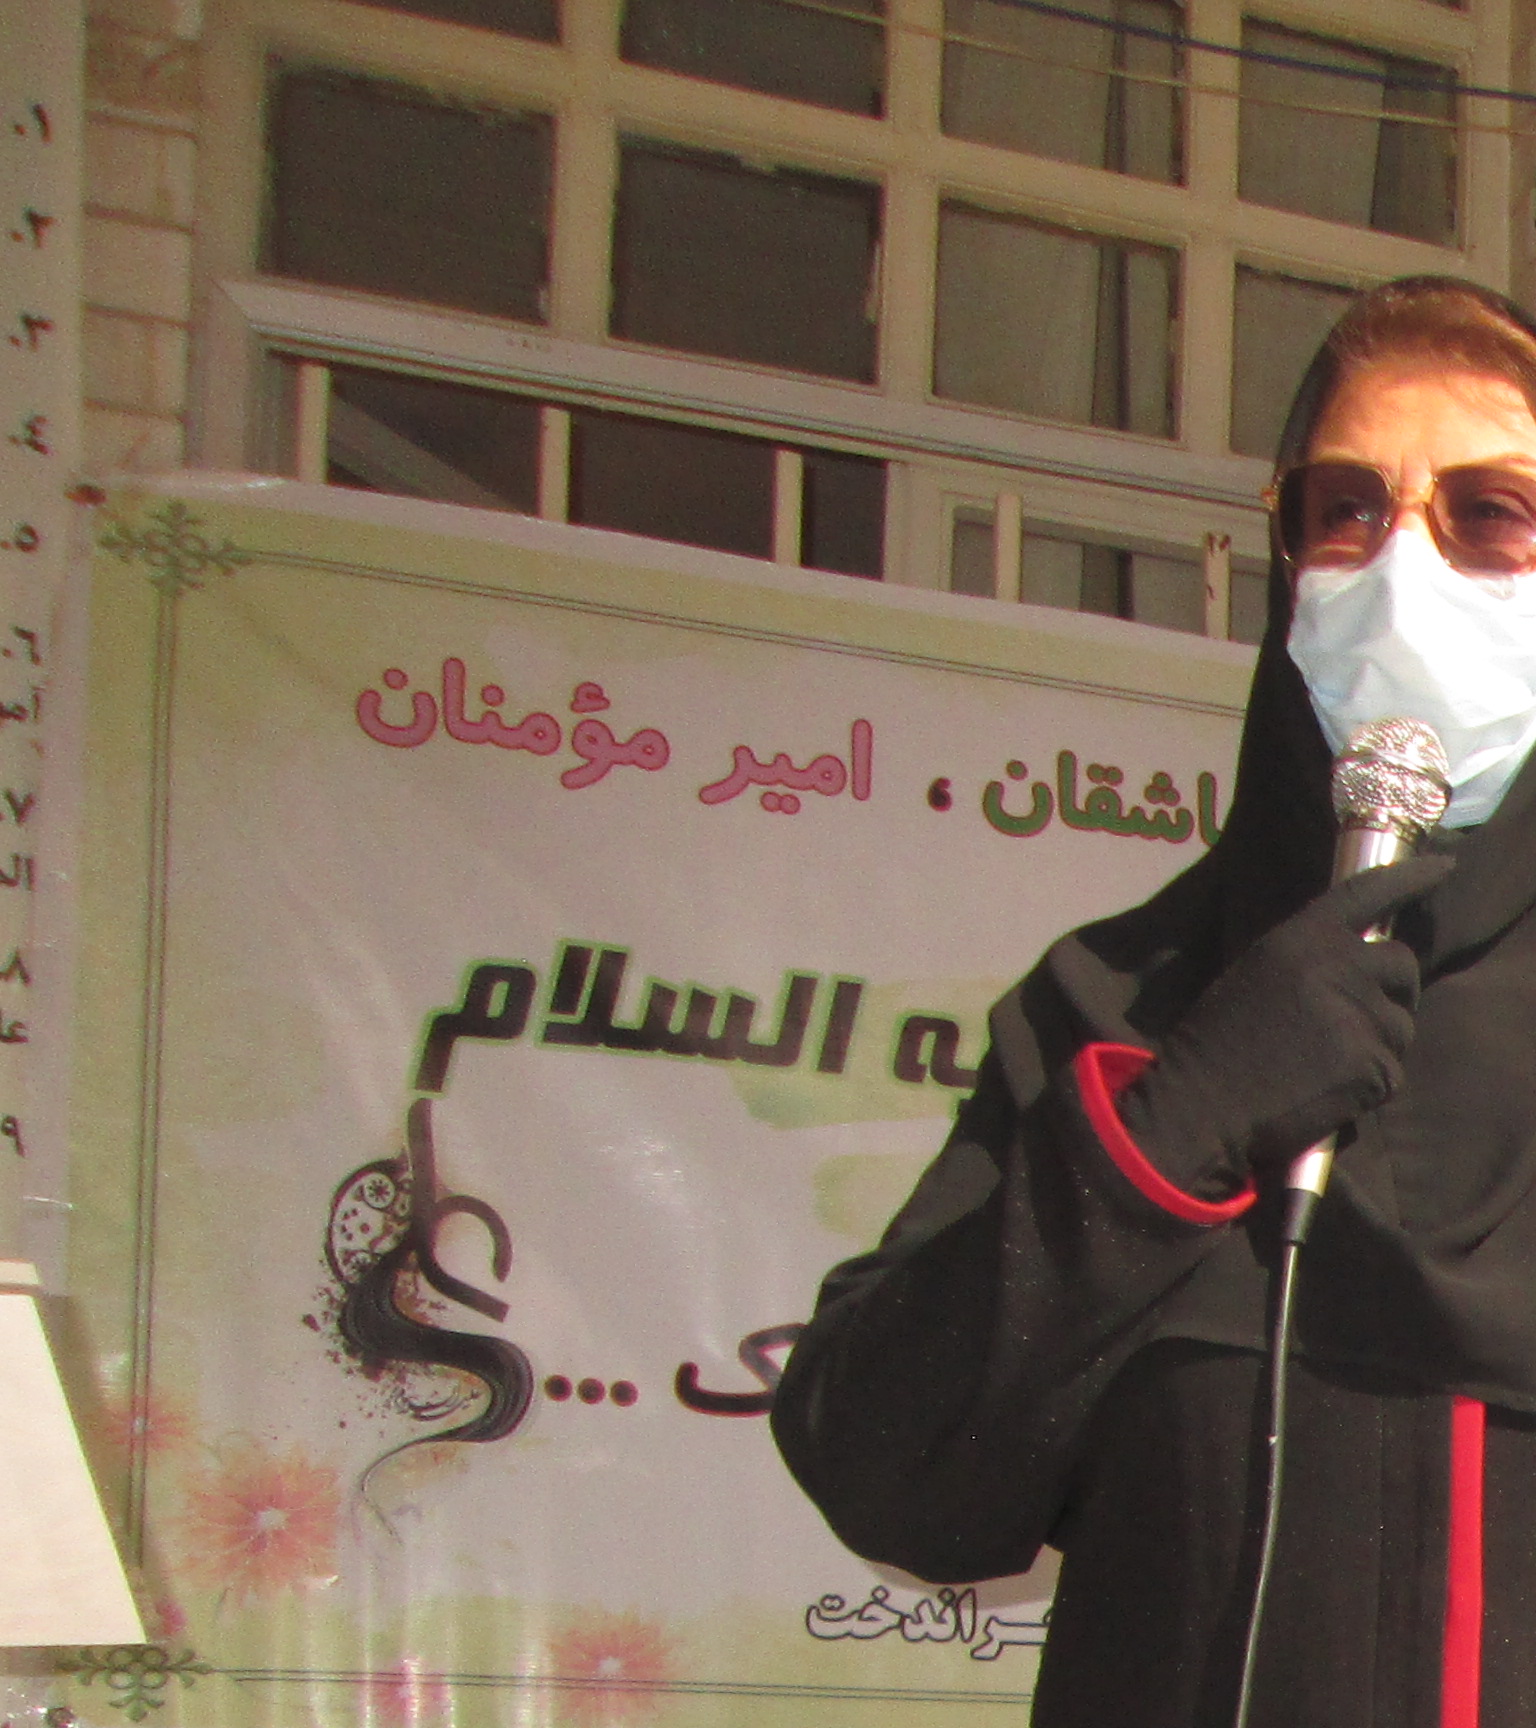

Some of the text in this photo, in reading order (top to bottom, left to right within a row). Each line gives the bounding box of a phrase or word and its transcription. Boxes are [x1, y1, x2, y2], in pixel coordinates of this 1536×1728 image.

[356, 656, 671, 790] مؤمنان
[699, 717, 873, 815] امیر
[408, 938, 865, 1095] السلام
